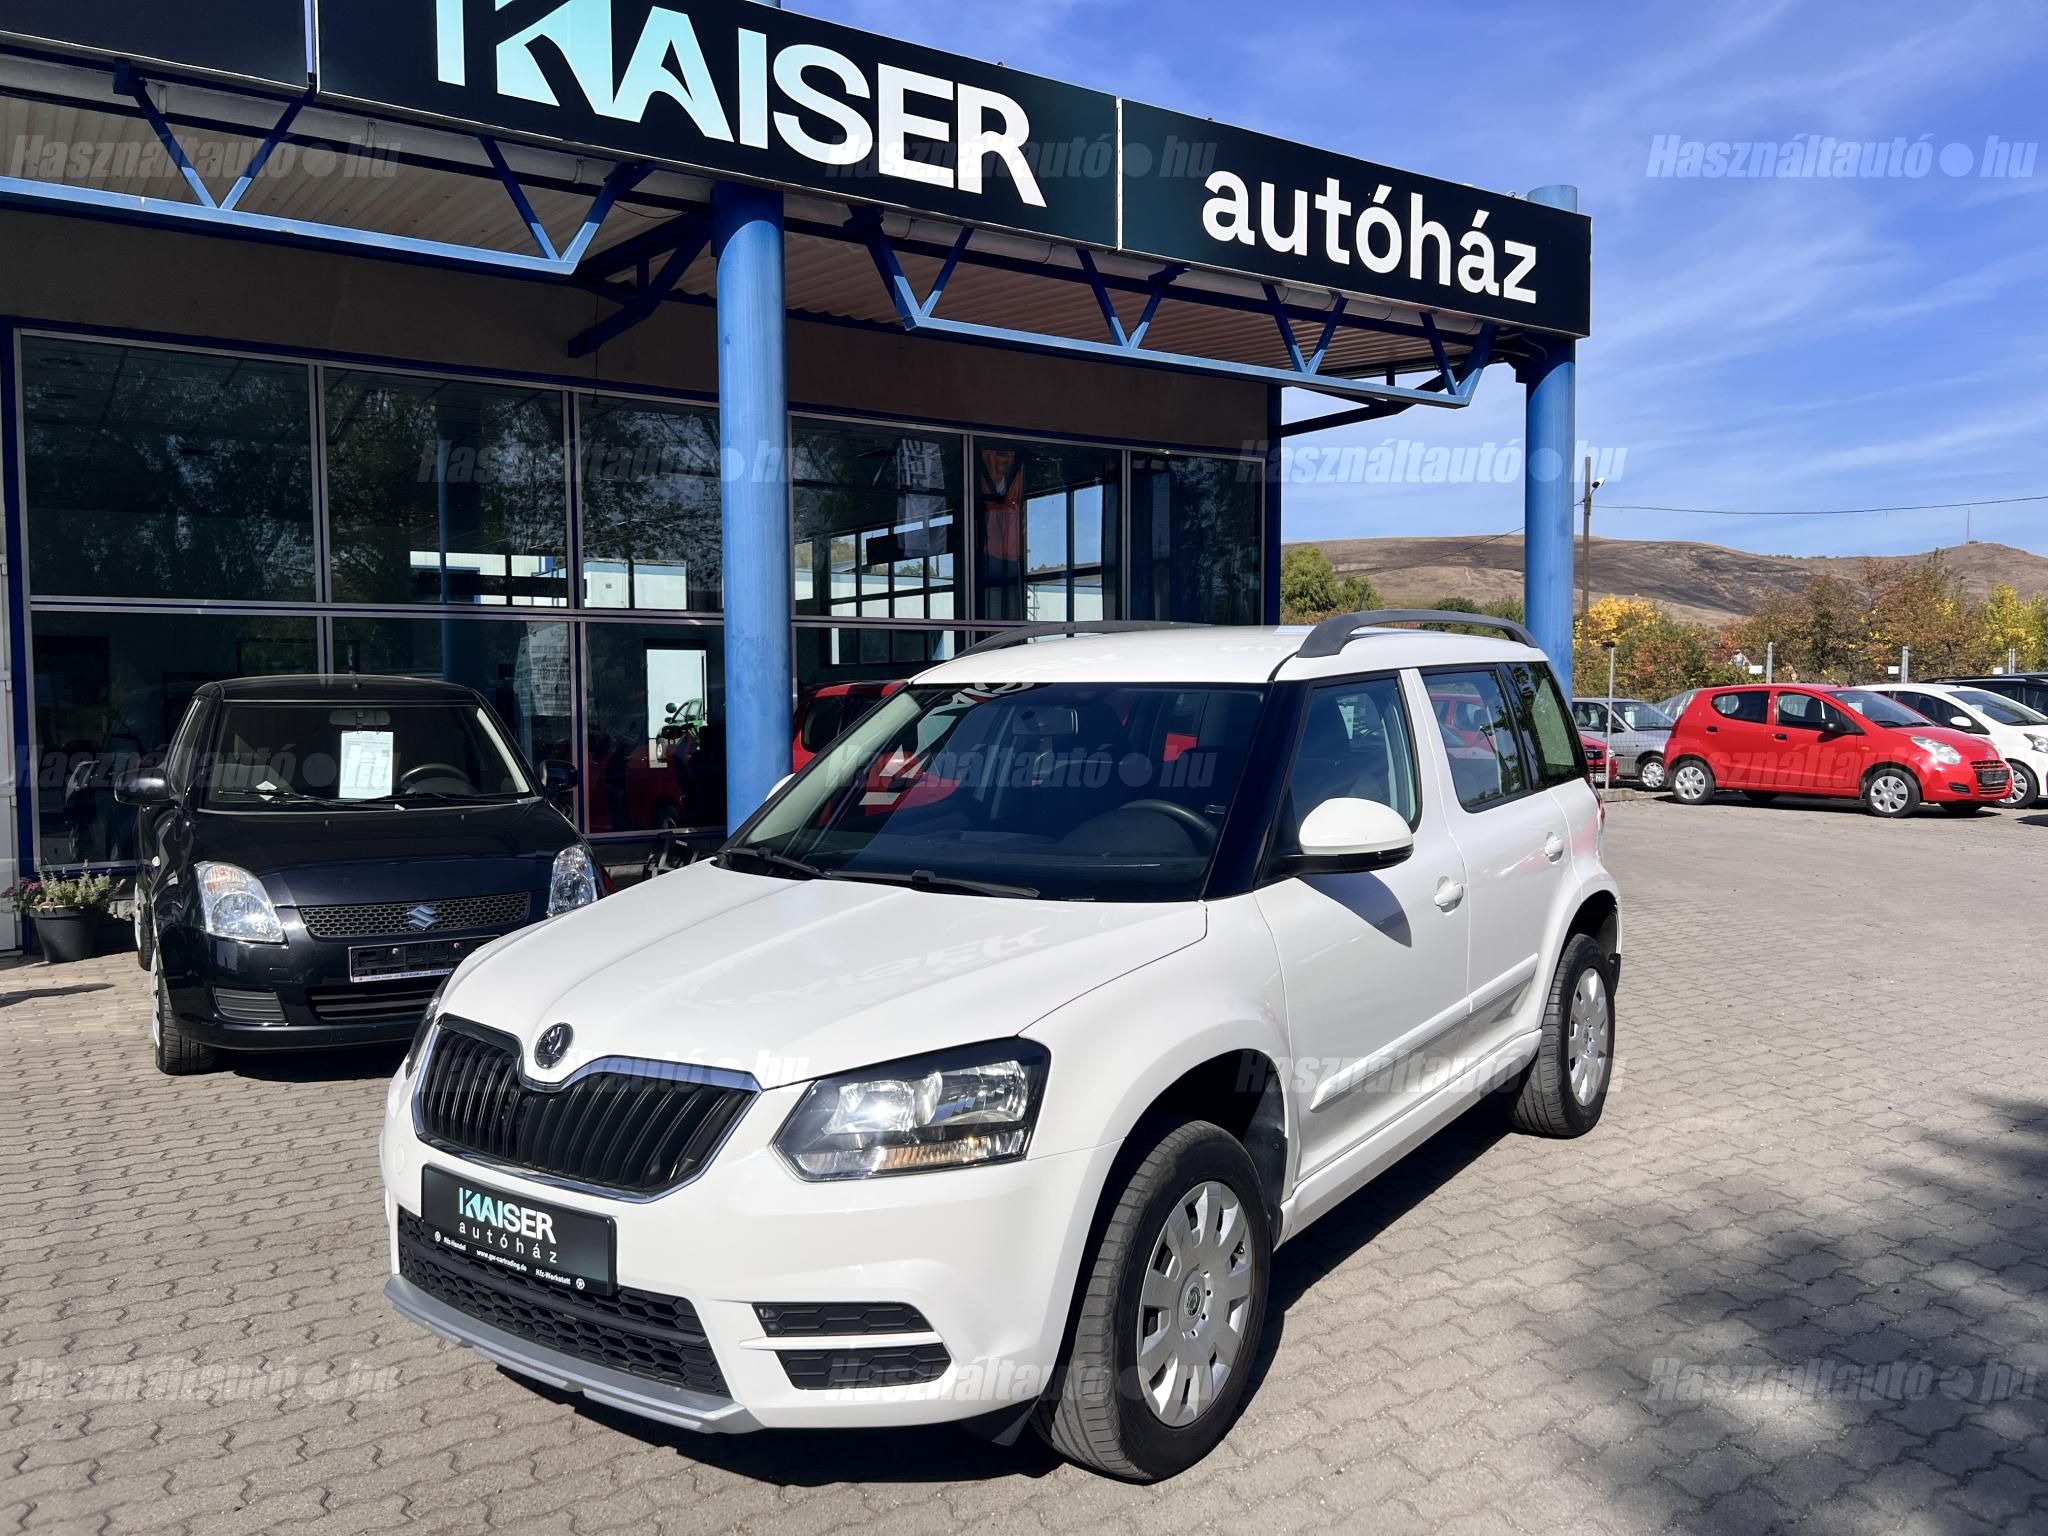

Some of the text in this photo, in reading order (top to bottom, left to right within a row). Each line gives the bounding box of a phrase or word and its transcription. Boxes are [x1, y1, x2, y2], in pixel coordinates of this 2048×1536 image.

[436, 0, 1046, 207] KAISER
[1202, 170, 1537, 304] autóház
[459, 1187, 556, 1244] KAISER
